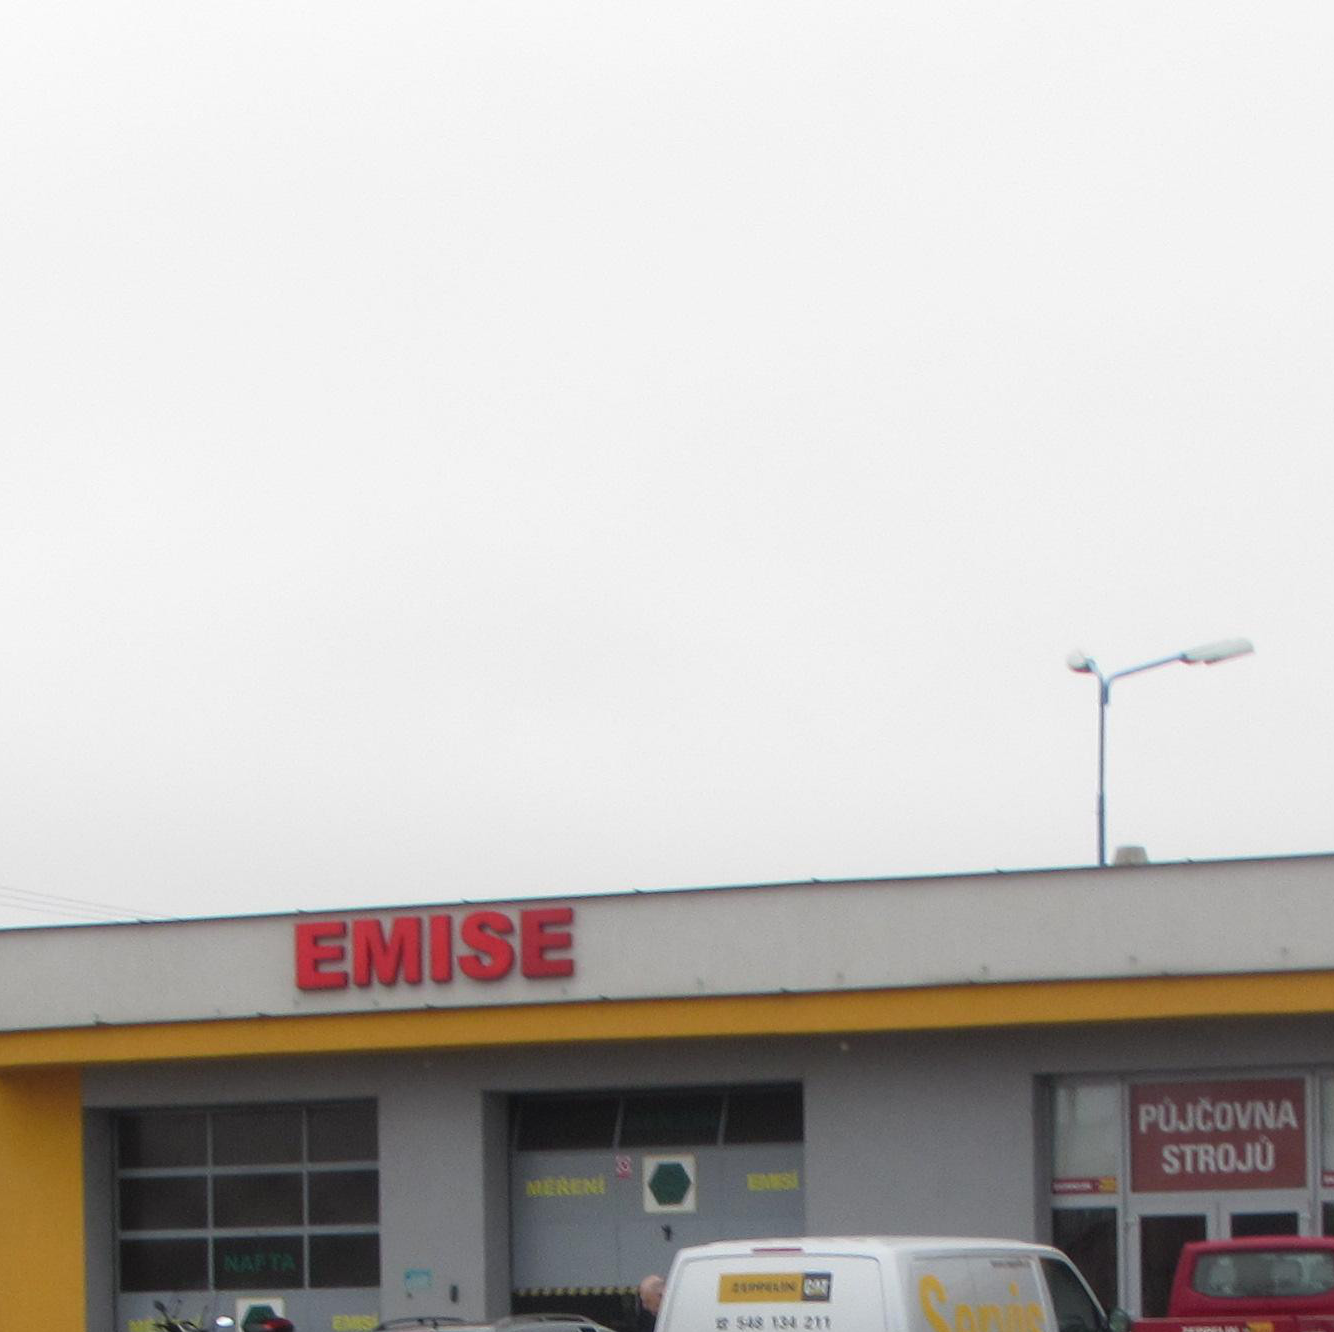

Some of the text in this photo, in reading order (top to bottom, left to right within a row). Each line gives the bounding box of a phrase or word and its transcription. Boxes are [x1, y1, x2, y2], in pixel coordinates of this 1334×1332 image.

[294, 907, 575, 991] EMISE
[1139, 1097, 1299, 1133] PŮJČOVNA
[1161, 1136, 1276, 1174] STROJŮ
[771, 1316, 798, 1330] 134
[804, 1316, 832, 1330] 211
